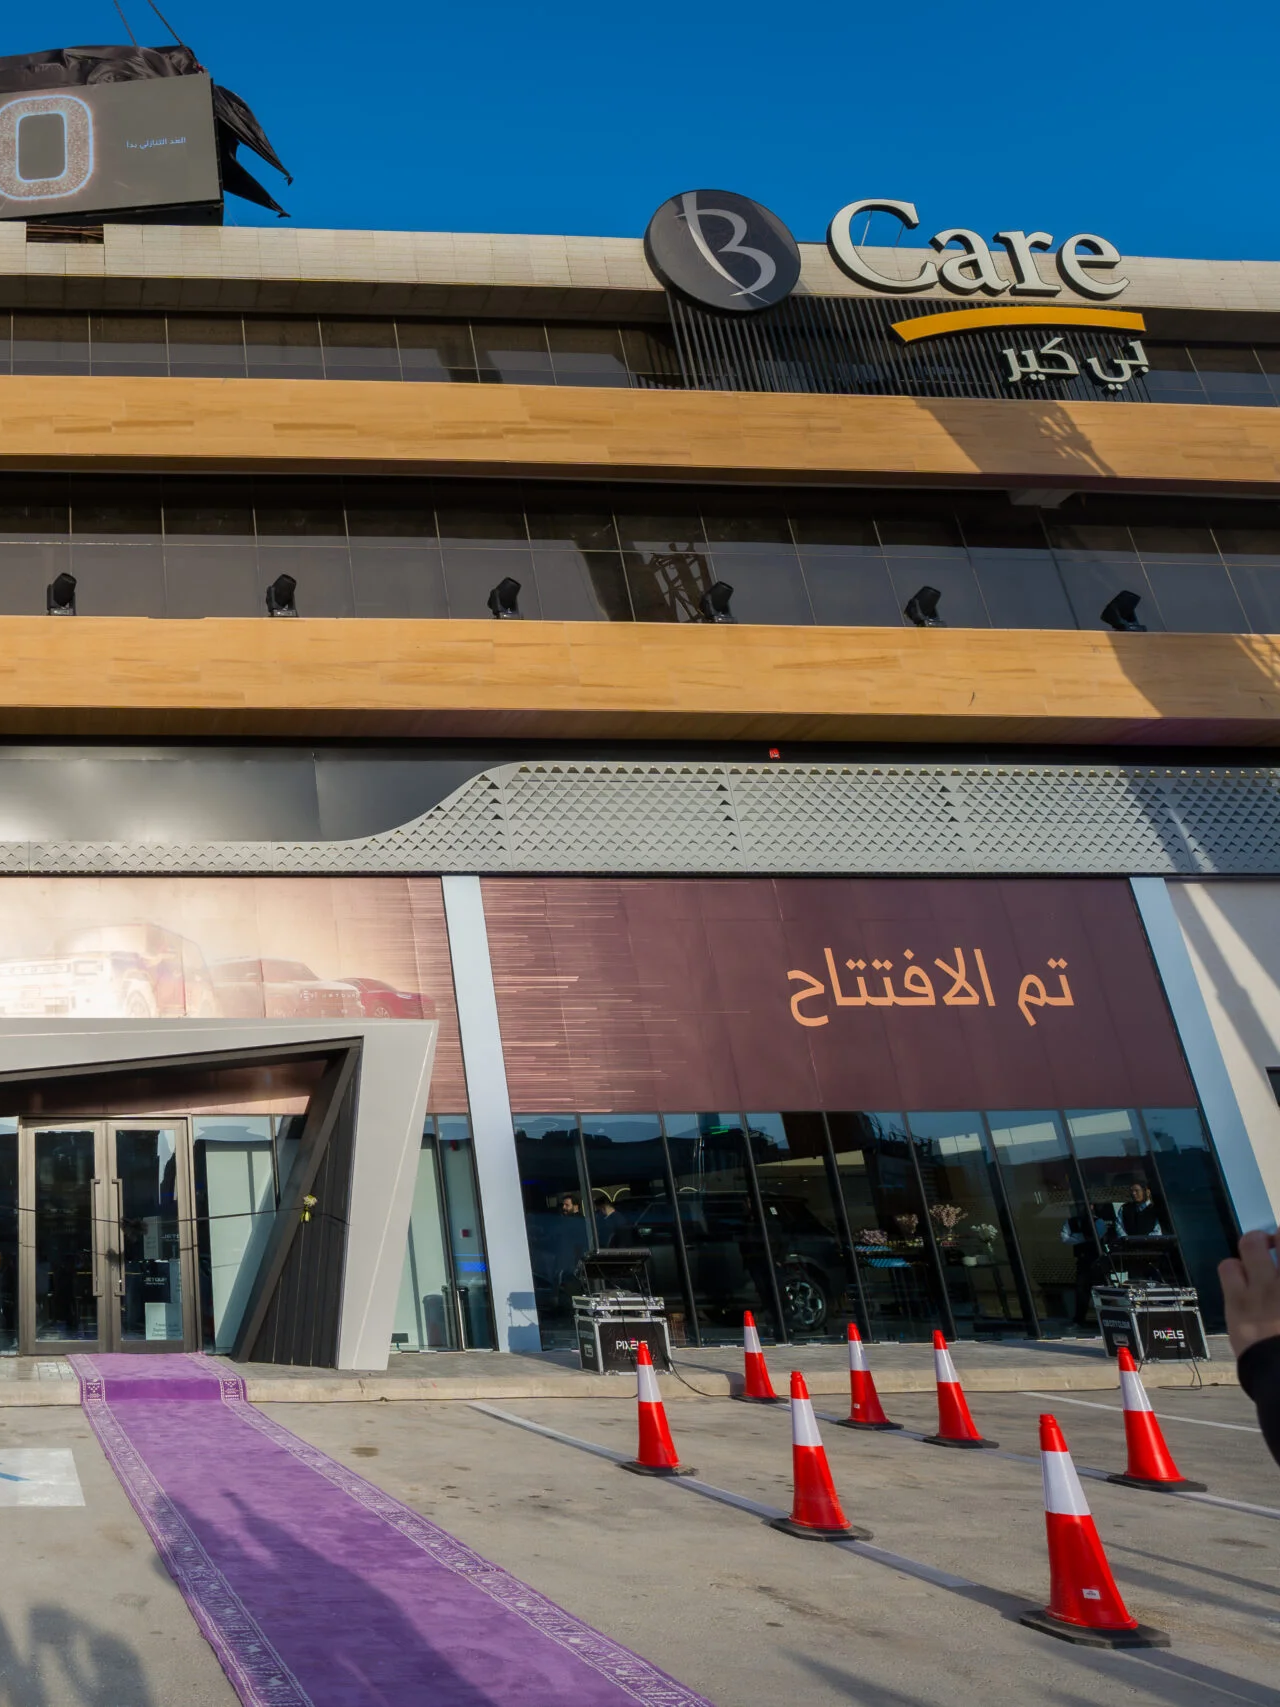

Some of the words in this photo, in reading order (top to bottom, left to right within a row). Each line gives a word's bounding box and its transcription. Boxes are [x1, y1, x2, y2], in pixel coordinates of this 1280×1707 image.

[826, 197, 1131, 301] Care
[1001, 336, 1081, 384] كير
[1087, 339, 1150, 391] بي
[786, 947, 996, 1027] الافتتاح
[1017, 957, 1075, 1027] تم
[1152, 1328, 1185, 1341] PIXELS
